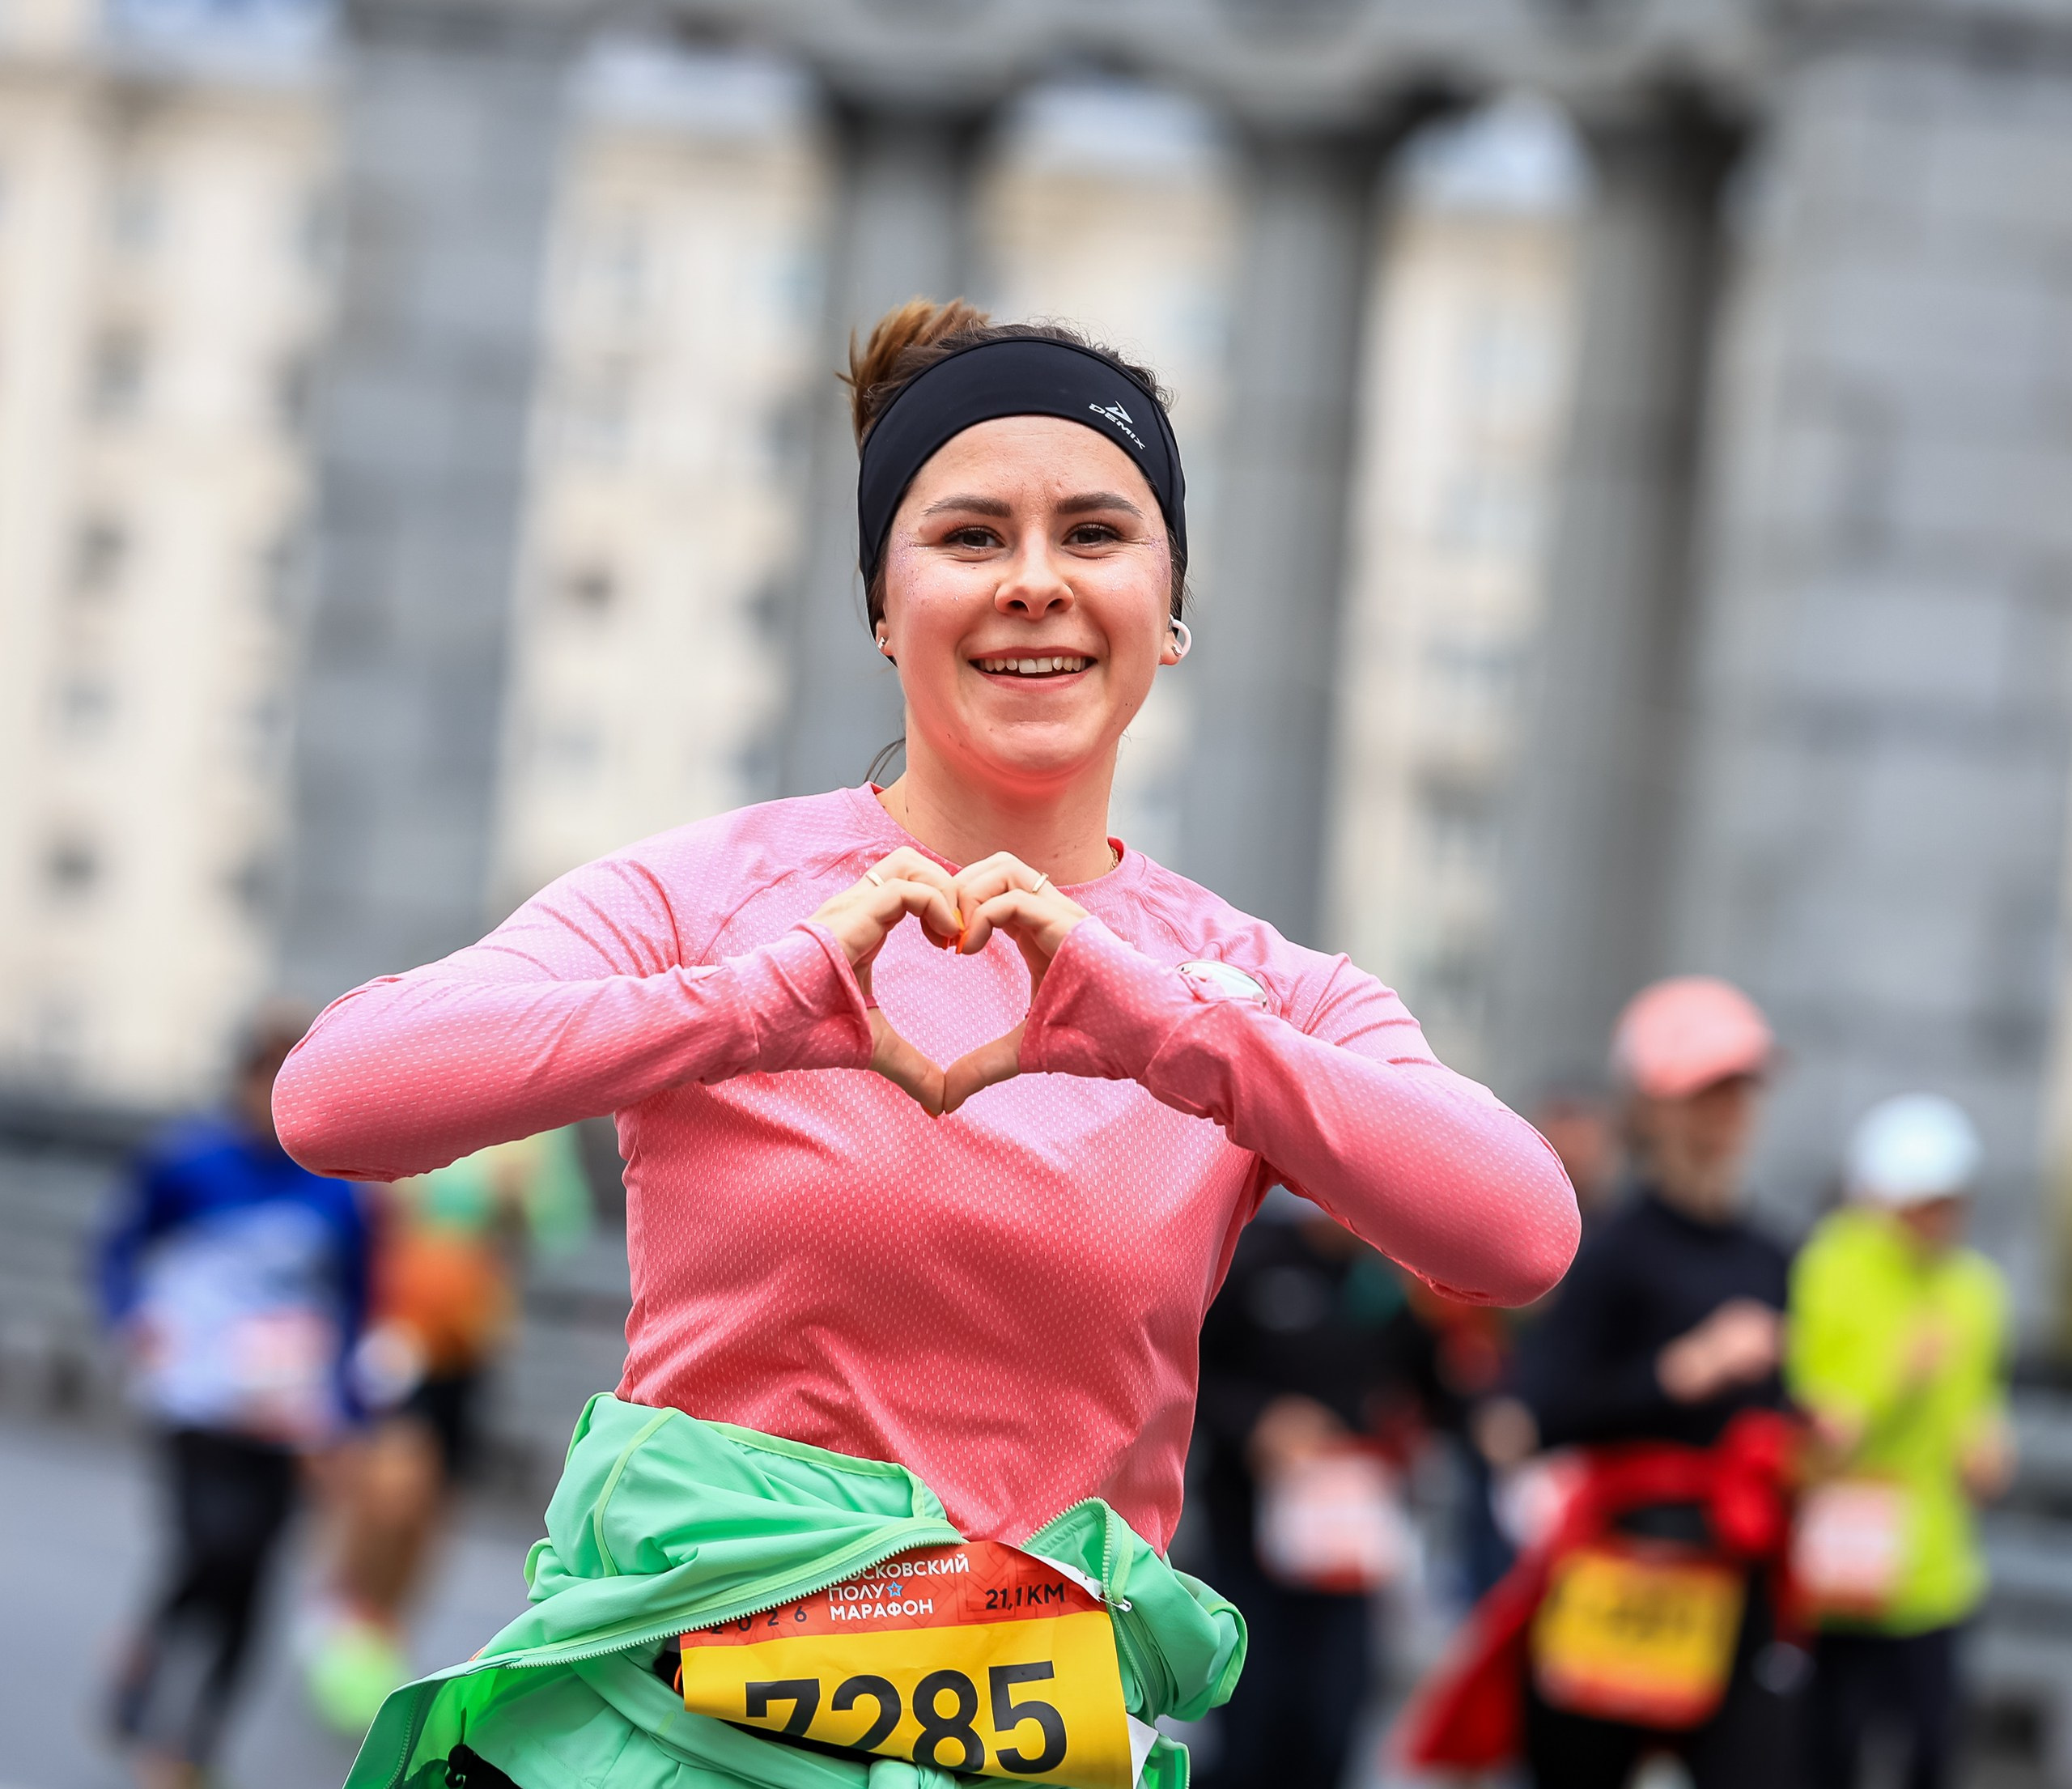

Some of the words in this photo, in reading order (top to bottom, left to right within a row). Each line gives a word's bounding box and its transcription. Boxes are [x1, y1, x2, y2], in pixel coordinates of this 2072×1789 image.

[1089, 403, 1146, 450] DEMIX
[845, 1553, 970, 1581] СКОВСКИЙ
[828, 1583, 885, 1602] ПОЛУ
[830, 1599, 934, 1621] МАРАФОН
[745, 1660, 1067, 1774] 7285
